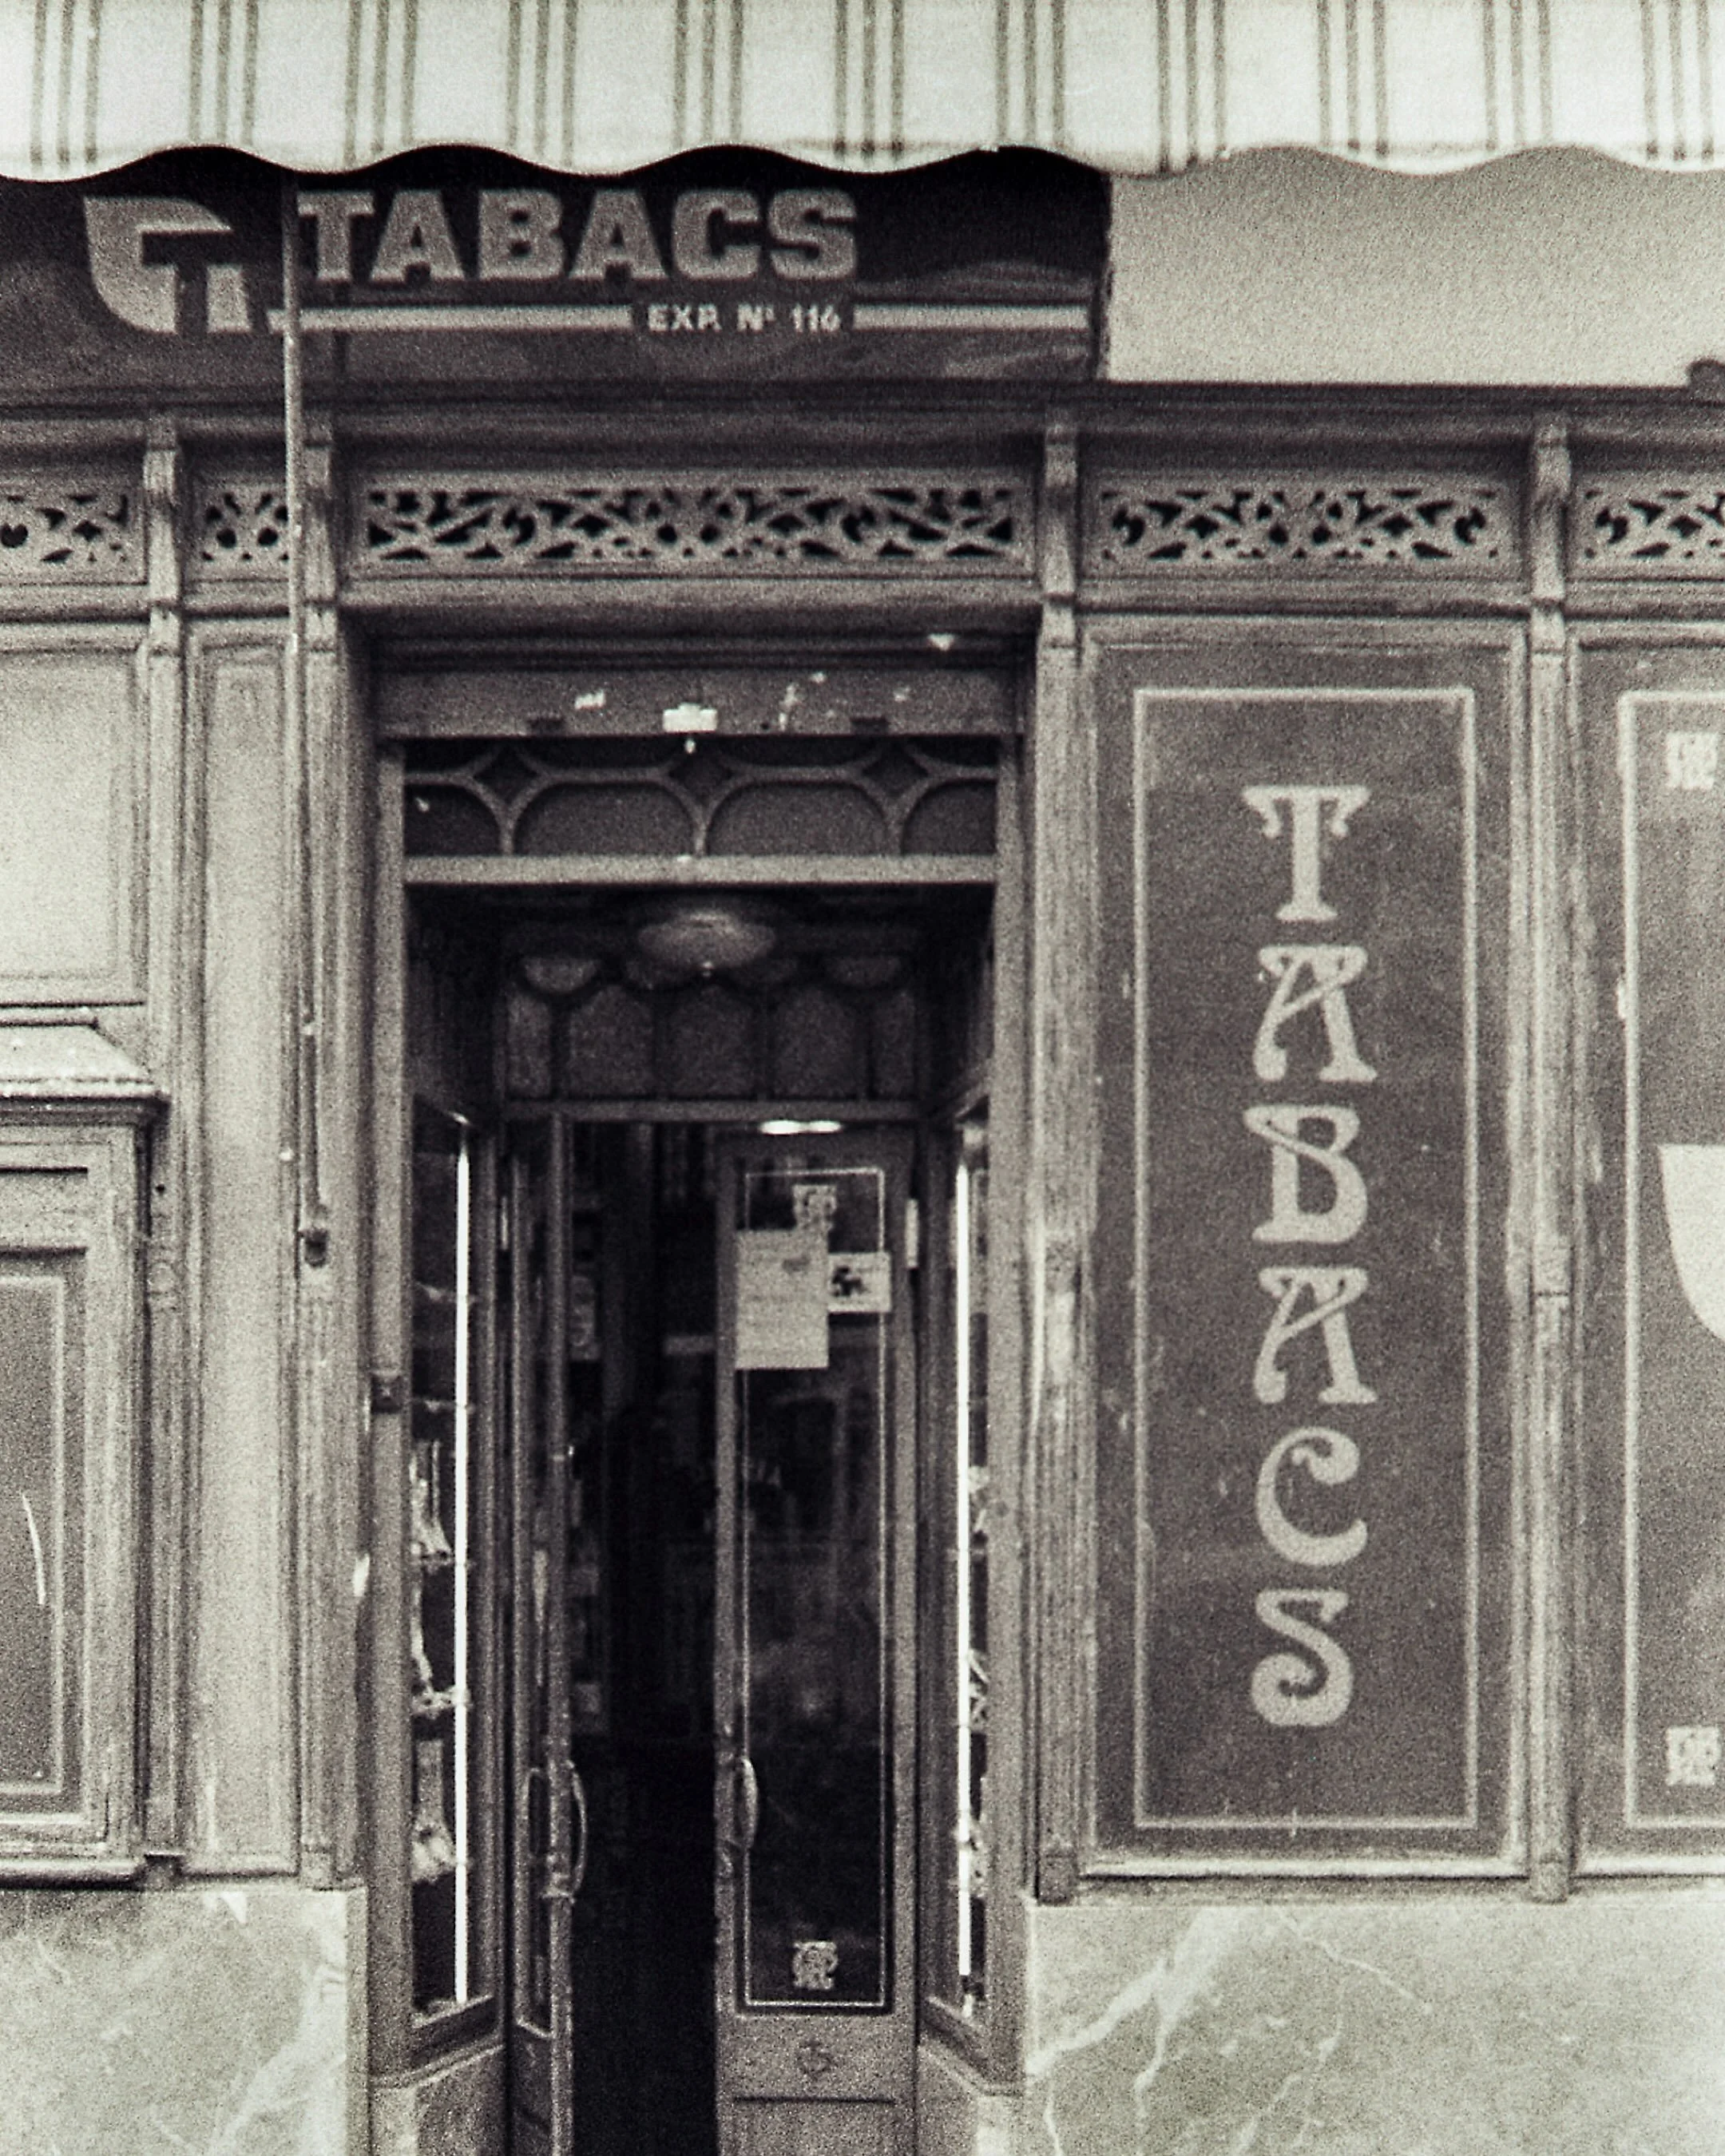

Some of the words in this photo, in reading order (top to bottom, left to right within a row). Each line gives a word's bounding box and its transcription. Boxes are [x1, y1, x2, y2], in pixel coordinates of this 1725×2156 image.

[297, 190, 858, 280] TABACS
[791, 303, 841, 333] 116
[1243, 785, 1378, 1726] TABACS
